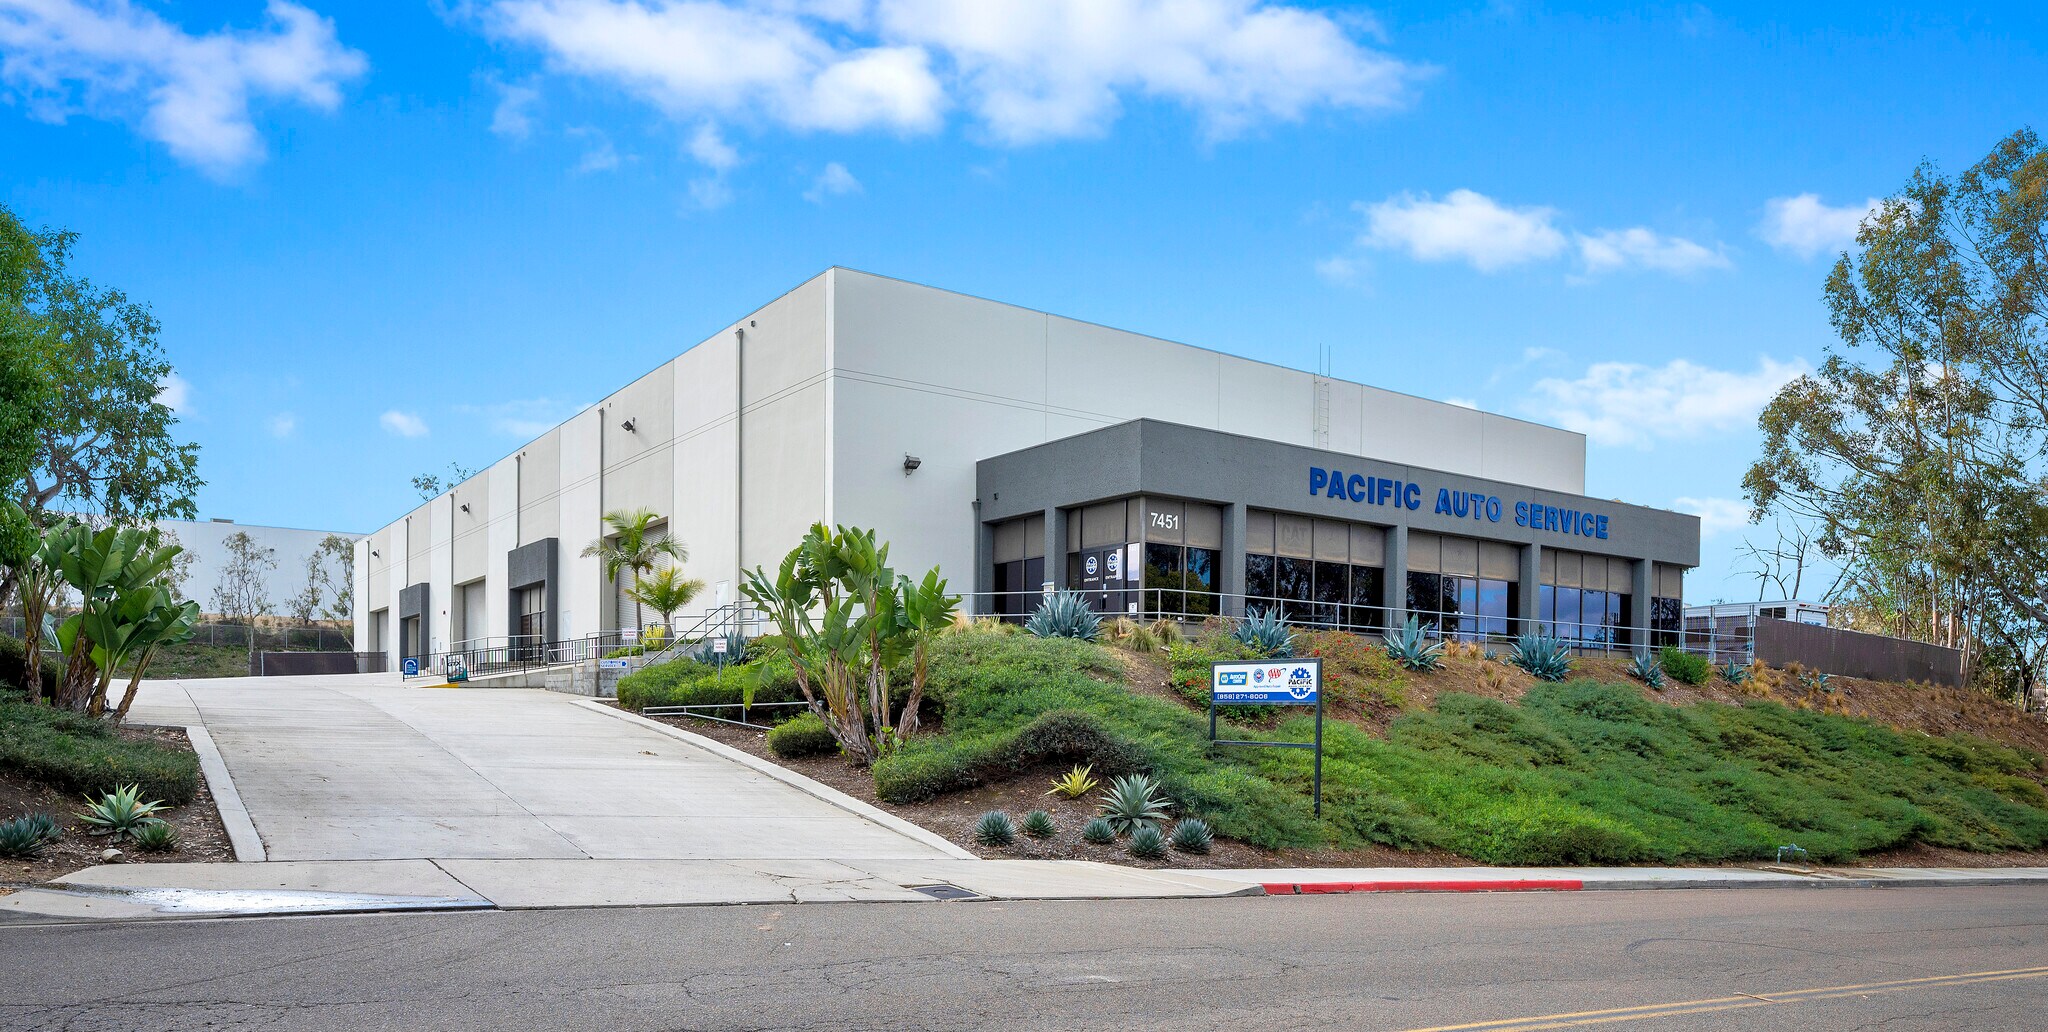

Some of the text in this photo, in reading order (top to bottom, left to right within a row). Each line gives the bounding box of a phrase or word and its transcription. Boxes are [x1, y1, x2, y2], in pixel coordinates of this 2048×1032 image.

[1150, 512, 1179, 530] 7451
[1309, 467, 1609, 540] PACIFIC AUTO SERVICE
